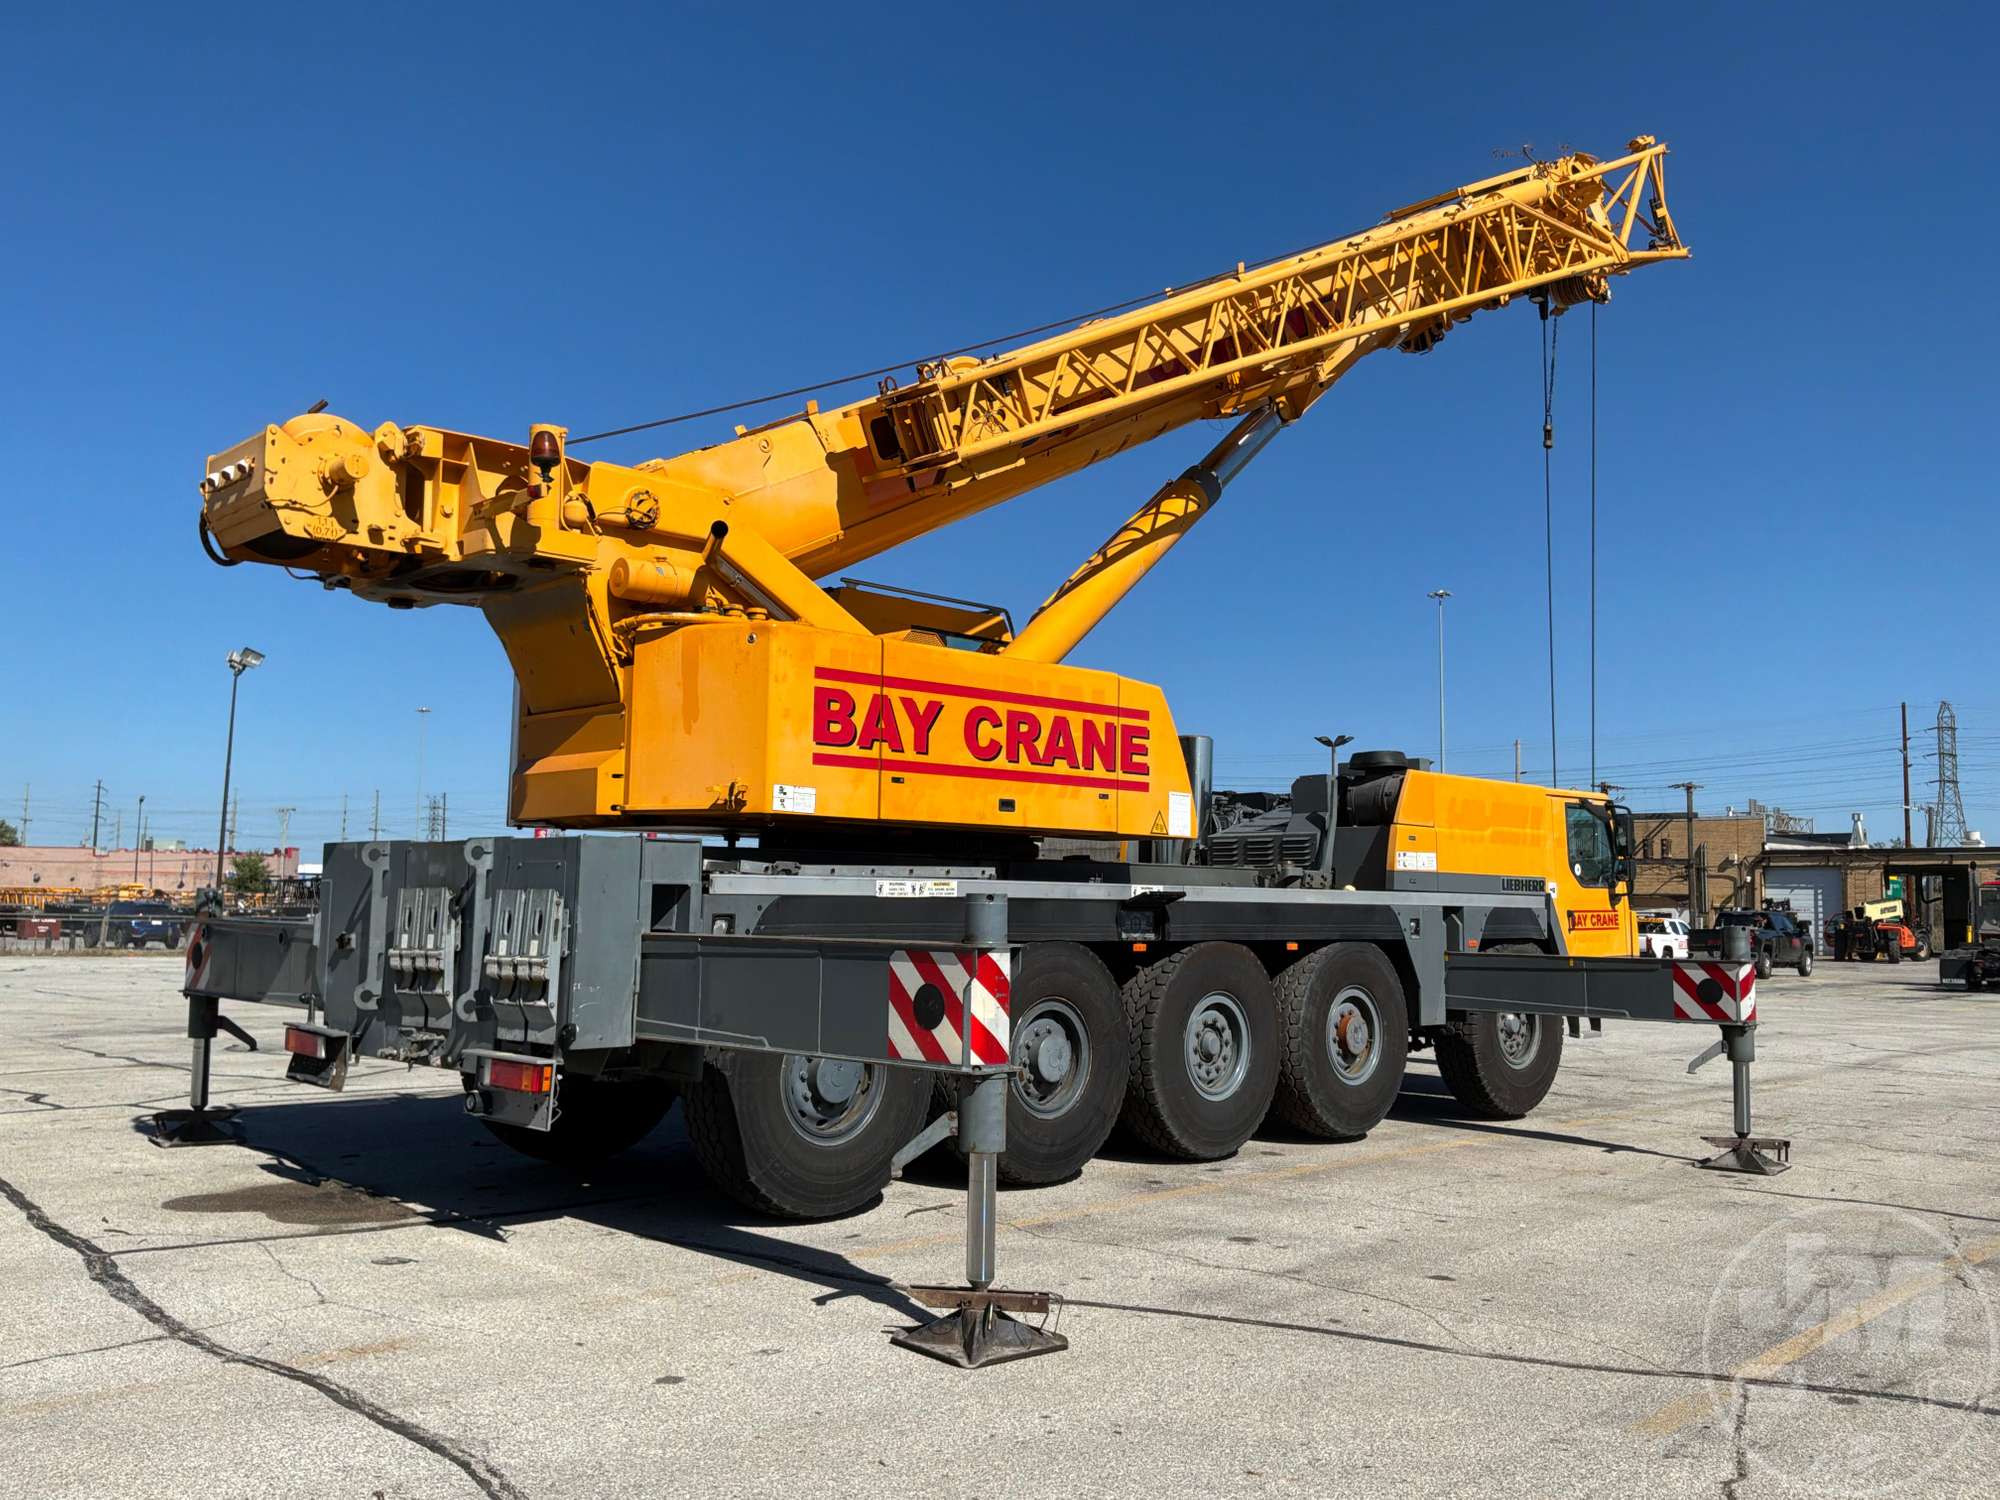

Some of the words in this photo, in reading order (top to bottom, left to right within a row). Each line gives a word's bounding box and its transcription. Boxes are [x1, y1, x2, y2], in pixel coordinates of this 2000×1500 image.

[813, 686, 946, 755] BAY
[963, 705, 1150, 776] CRANE
[1502, 878, 1545, 892] LIEBHERR
[1590, 913, 1619, 927] CRANE
